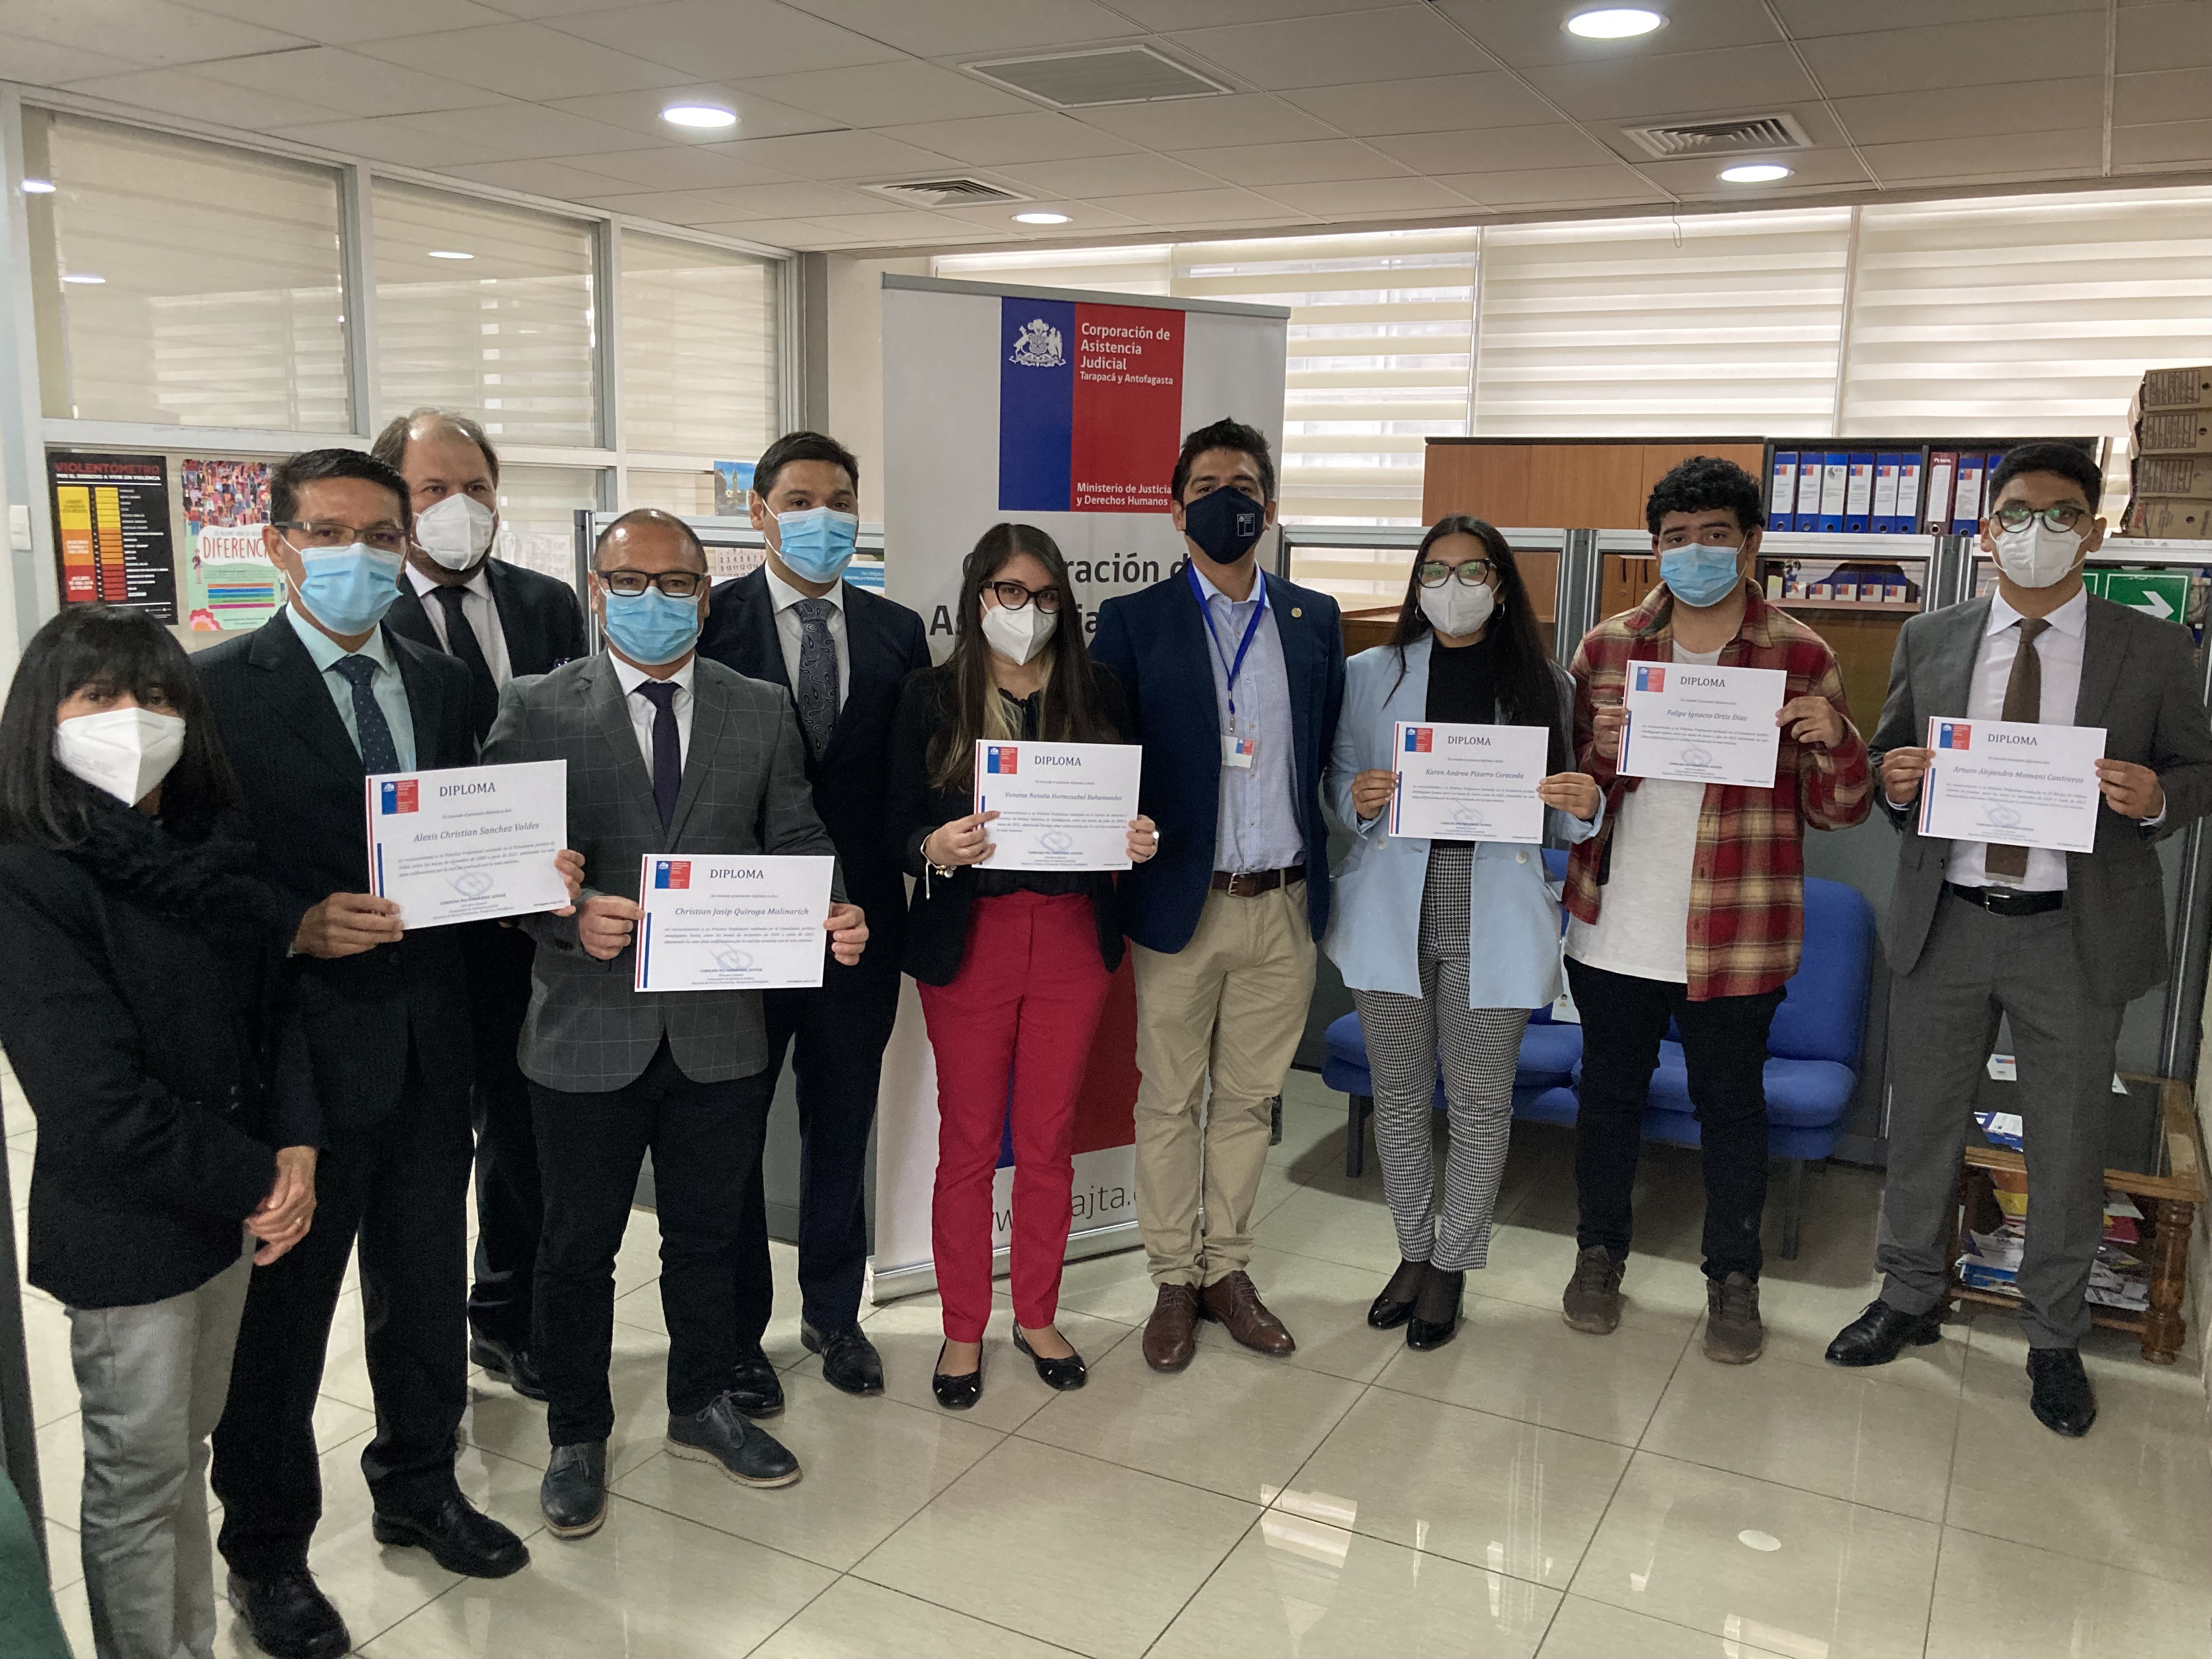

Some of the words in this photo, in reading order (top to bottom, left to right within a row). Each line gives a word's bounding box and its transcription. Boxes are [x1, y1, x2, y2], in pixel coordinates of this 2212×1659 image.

[1081, 322, 1153, 339] Corporación
[1156, 328, 1171, 341] de
[1081, 339, 1142, 355] Asistencia
[1080, 356, 1127, 370] Judicial
[1080, 371, 1116, 383] Tarapacá
[1118, 375, 1124, 384] y
[1125, 374, 1173, 386] Antofagasta
[1077, 482, 1123, 493] Ministerio
[1125, 483, 1136, 494] de
[1138, 484, 1172, 494] Justicia
[1076, 496, 1082, 506] y
[1085, 495, 1125, 505] Derechos
[1128, 495, 1168, 506] Humanos
[1170, 553, 1188, 579] d
[1680, 676, 1725, 688] DIPLOMA
[1666, 709, 1687, 718] Felipe
[1688, 711, 1713, 719] Ignacio
[1447, 736, 1491, 746] DIPLOMA
[1988, 733, 2038, 746] DIPLOMA
[1035, 755, 1081, 766] DIPLOMA
[1953, 766, 1977, 774] Arturo
[1978, 769, 2013, 777] Alejandro
[2015, 772, 2045, 780] Mamani
[2047, 774, 2084, 784] Contreras
[439, 781, 496, 797] DIPLOMA
[413, 833, 438, 843] Alexis
[440, 829, 477, 840] Christian
[479, 825, 512, 836] Sanchez
[514, 822, 539, 832] Valdes
[710, 868, 764, 879] DIPLOMA
[675, 907, 711, 916] Christian
[712, 907, 732, 917] Josip
[733, 907, 765, 917] Quiroga
[767, 907, 809, 916] Malinarich
